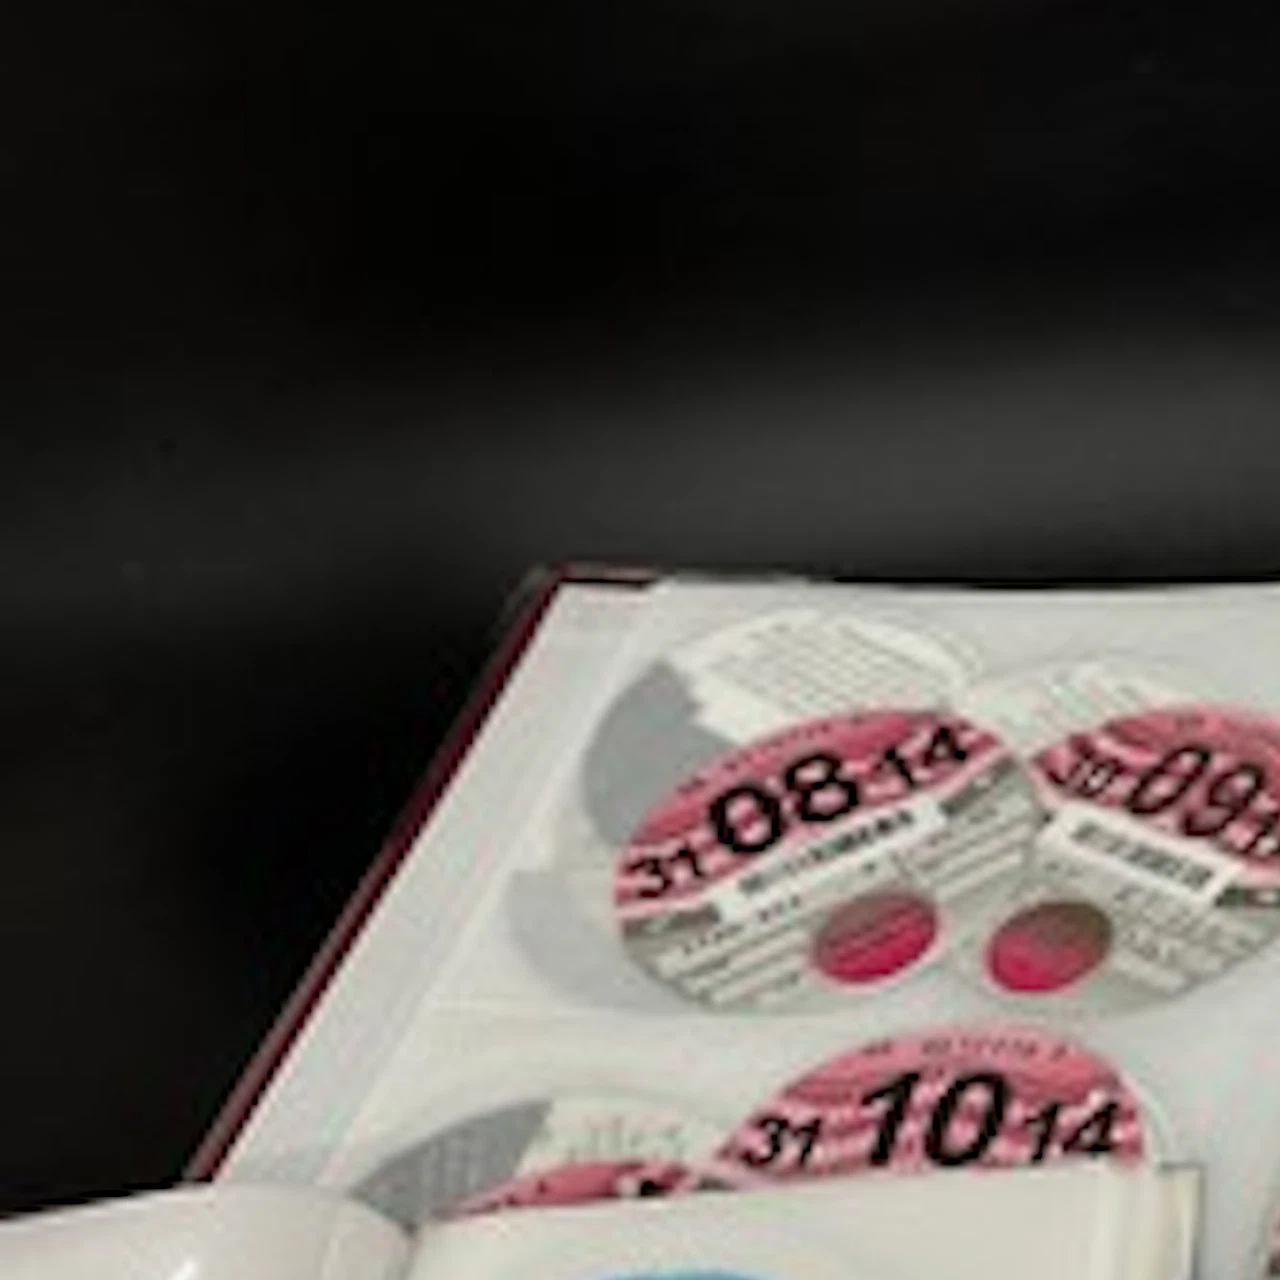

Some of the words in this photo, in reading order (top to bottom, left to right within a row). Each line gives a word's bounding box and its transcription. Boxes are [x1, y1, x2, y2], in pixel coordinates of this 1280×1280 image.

[626, 840, 706, 900] 31
[707, 752, 859, 856] 08
[873, 725, 969, 789] 14
[1125, 744, 1267, 839] 09
[739, 1116, 822, 1167] 31
[861, 1070, 1012, 1167] 10
[1025, 1098, 1119, 1165] 14
